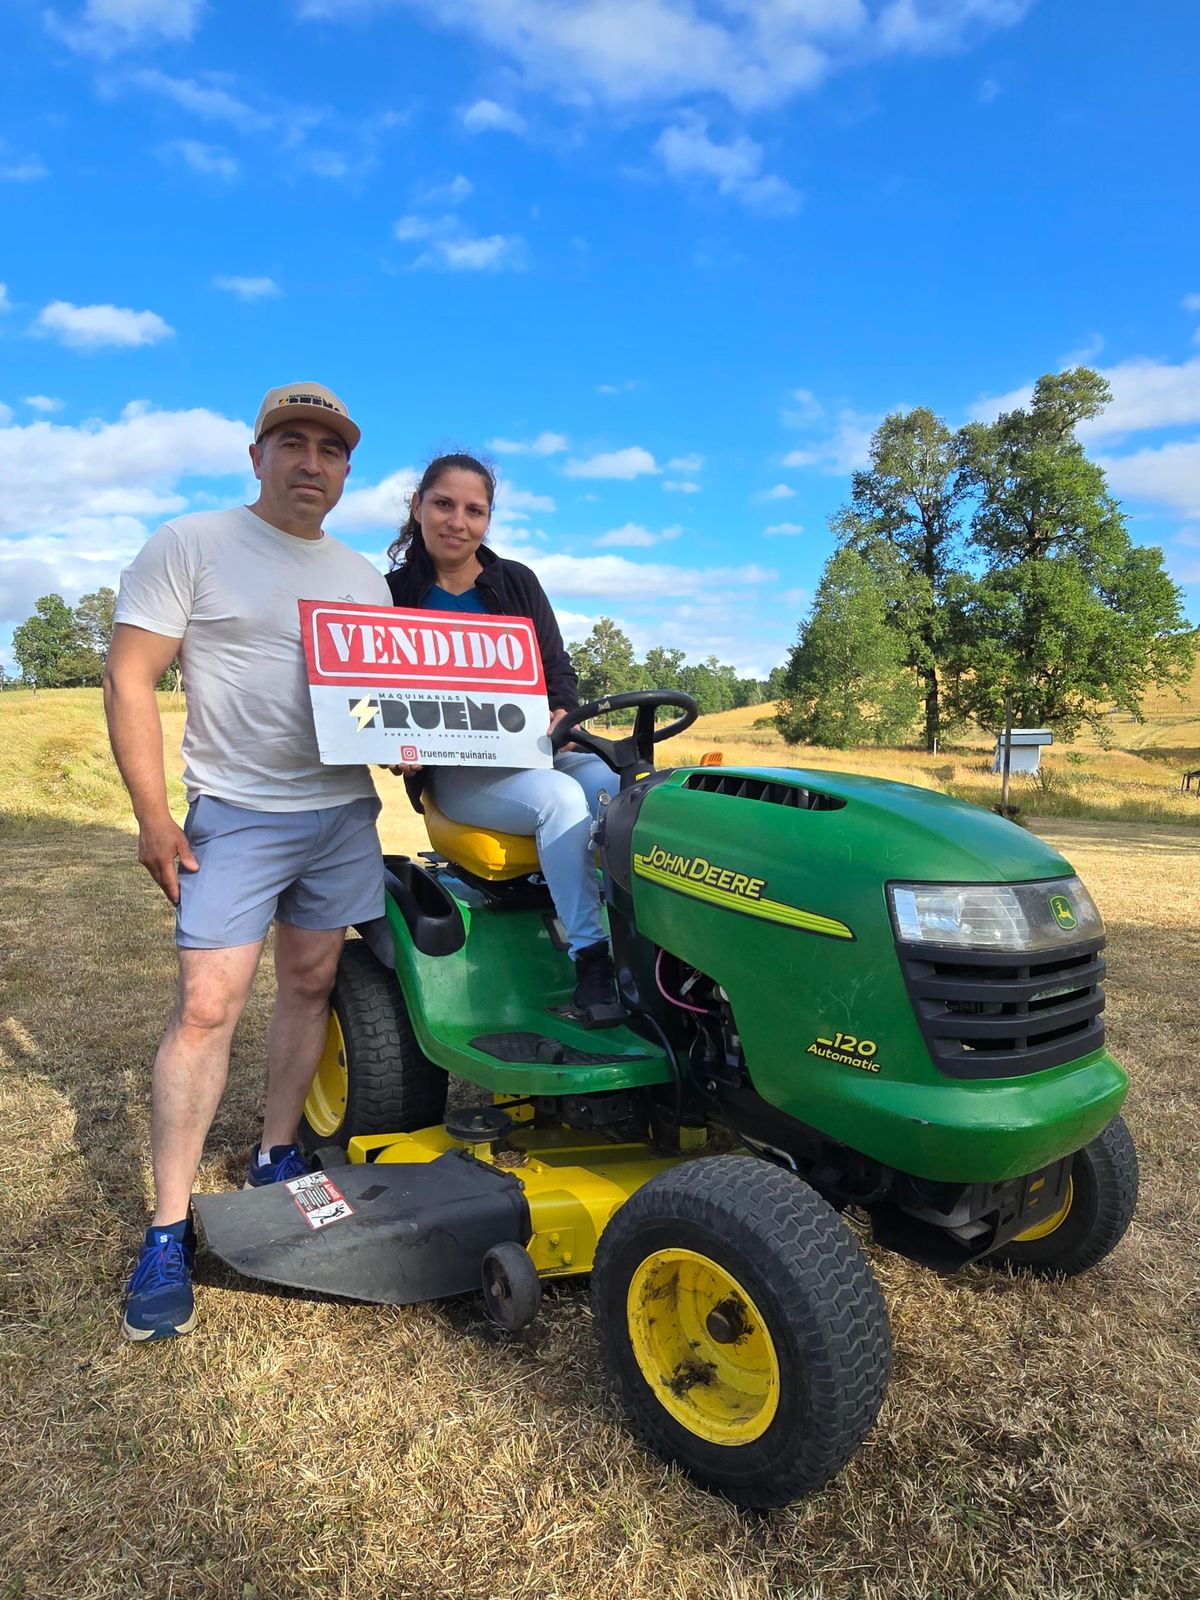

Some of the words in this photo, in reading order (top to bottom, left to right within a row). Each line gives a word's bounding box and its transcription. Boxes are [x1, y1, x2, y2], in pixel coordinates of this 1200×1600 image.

[326, 622, 525, 671] VENDIDO
[348, 693, 526, 734] TRUENO
[378, 692, 461, 701] MAQUINARIAS
[419, 749, 497, 762] truenomquinarias
[642, 845, 691, 876] JOHN
[688, 857, 765, 898] DEERE
[807, 1043, 881, 1073] Automatic
